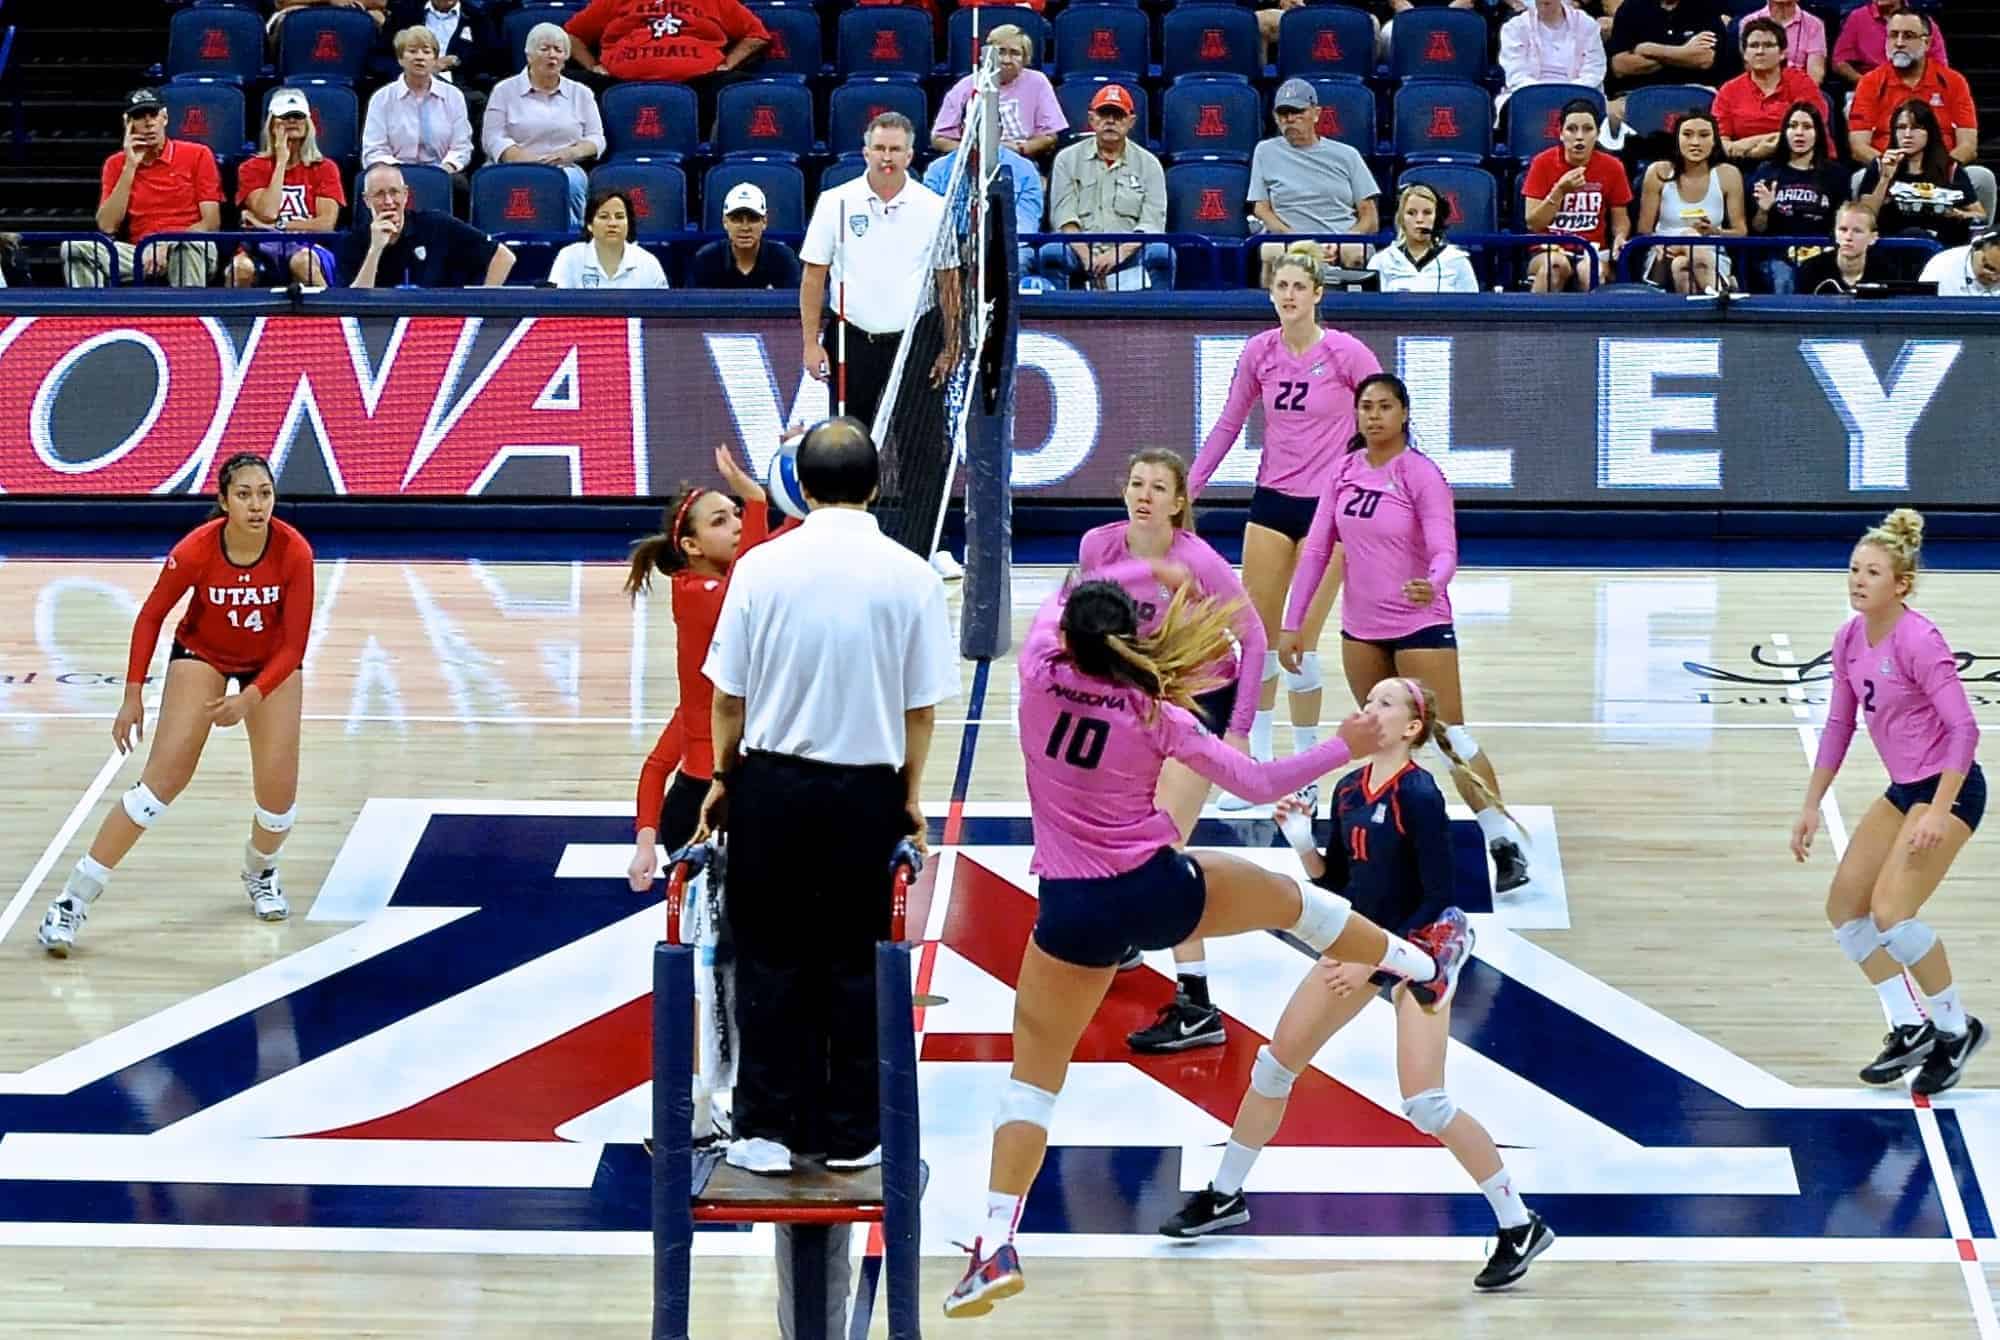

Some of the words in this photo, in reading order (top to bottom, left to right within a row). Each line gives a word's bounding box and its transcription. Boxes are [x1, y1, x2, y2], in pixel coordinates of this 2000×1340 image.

[1274, 381, 1309, 411] 22
[1343, 486, 1383, 518] 20
[208, 585, 280, 606] UTAH
[227, 608, 264, 632] 14
[1046, 682, 1126, 711] ARIZONA
[1863, 679, 1876, 712] 2
[1045, 711, 1111, 770] 10
[1351, 825, 1369, 861] 11
